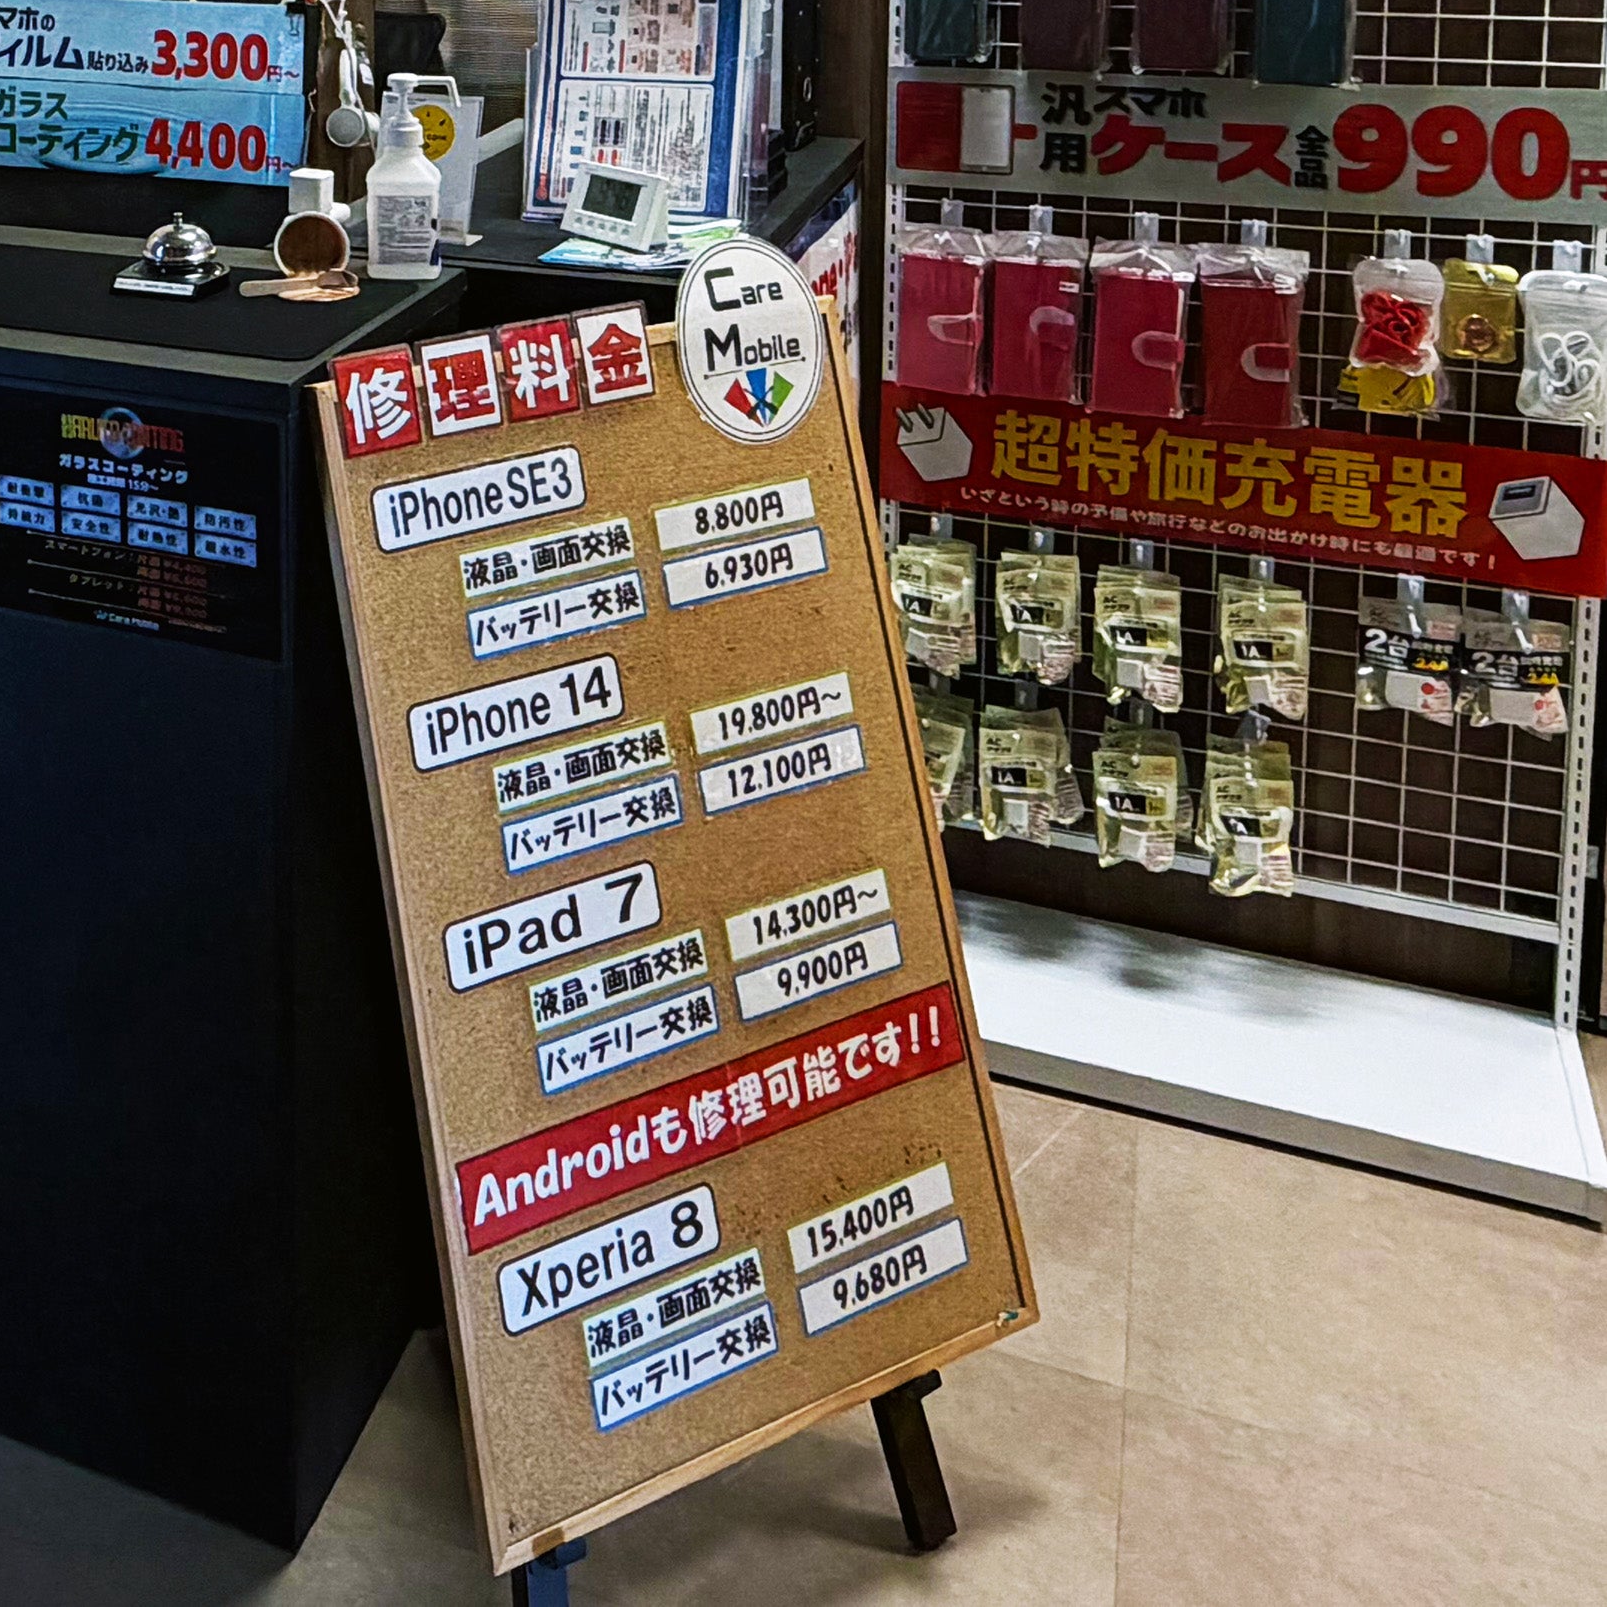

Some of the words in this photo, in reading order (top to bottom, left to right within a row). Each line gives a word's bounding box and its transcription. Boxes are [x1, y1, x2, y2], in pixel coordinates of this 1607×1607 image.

[1094, 86, 1207, 119] スマホ
[1092, 115, 1292, 187] ケース
[1294, 126, 1331, 189] 全品
[704, 268, 783, 313] Care
[345, 323, 648, 444] 修理料金
[704, 325, 803, 374] Mobile
[59, 454, 189, 484] ガラスコーティング
[991, 408, 1469, 539] 超特価充電器
[463, 524, 632, 591] 液晶・画面交換
[475, 579, 641, 648] バッテリー交換
[425, 697, 552, 755] iPhone
[560, 666, 611, 719] 14
[498, 731, 666, 802] 液晶・画面交換
[510, 788, 676, 862] バッテリー交換
[463, 895, 582, 975] iPad
[604, 874, 643, 924] 7
[534, 940, 705, 1021] 液晶・画面交換
[545, 996, 713, 1083] バッテリー交換
[474, 1006, 941, 1227] Androidも修理可能です!!
[516, 1228, 654, 1316] Xperia
[671, 1201, 704, 1248] 8
[590, 1264, 761, 1358] 液晶・画面交換
[600, 1316, 771, 1415] バッテリー交換
